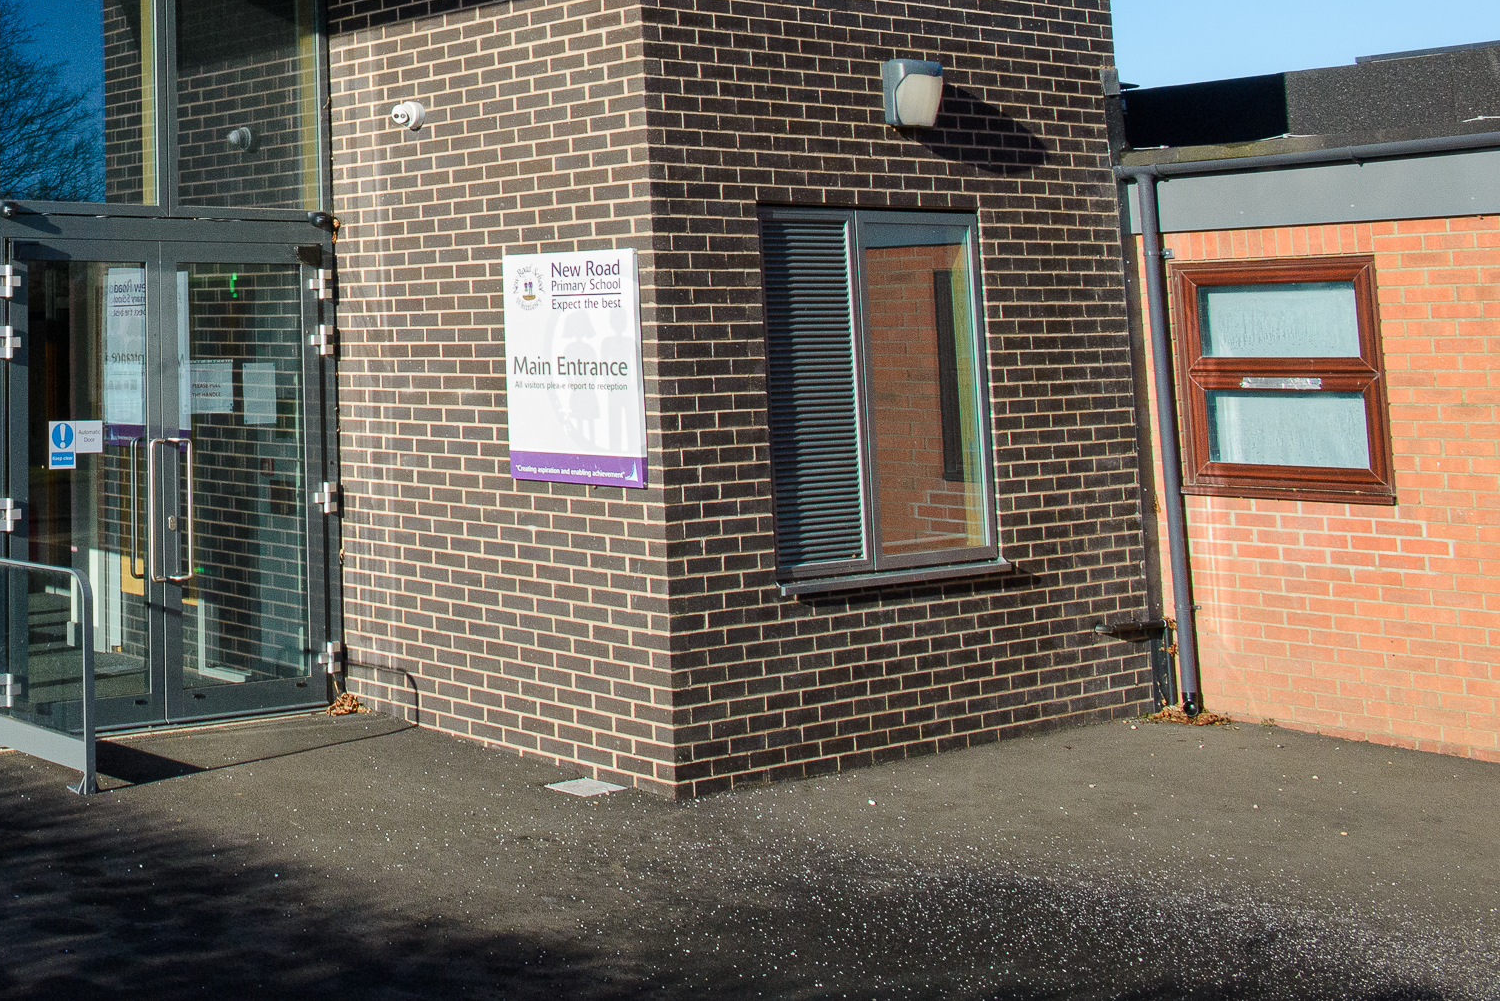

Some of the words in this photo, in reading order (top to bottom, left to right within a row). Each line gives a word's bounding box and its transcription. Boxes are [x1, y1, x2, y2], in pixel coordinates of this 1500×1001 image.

[551, 262, 581, 278] New
[586, 258, 620, 277] Road
[551, 279, 587, 294] Primary
[589, 278, 621, 290] School
[552, 298, 582, 312] Expect
[584, 298, 599, 309] the
[602, 297, 622, 309] best
[513, 356, 552, 376] Main
[557, 356, 628, 377] Entrance
[514, 381, 523, 389] All
[524, 380, 546, 390] visitors
[568, 382, 588, 392] report
[588, 382, 596, 390] to
[596, 382, 628, 392] reception
[538, 466, 560, 475] aspiration
[561, 468, 570, 476] and
[570, 468, 592, 478] enabling
